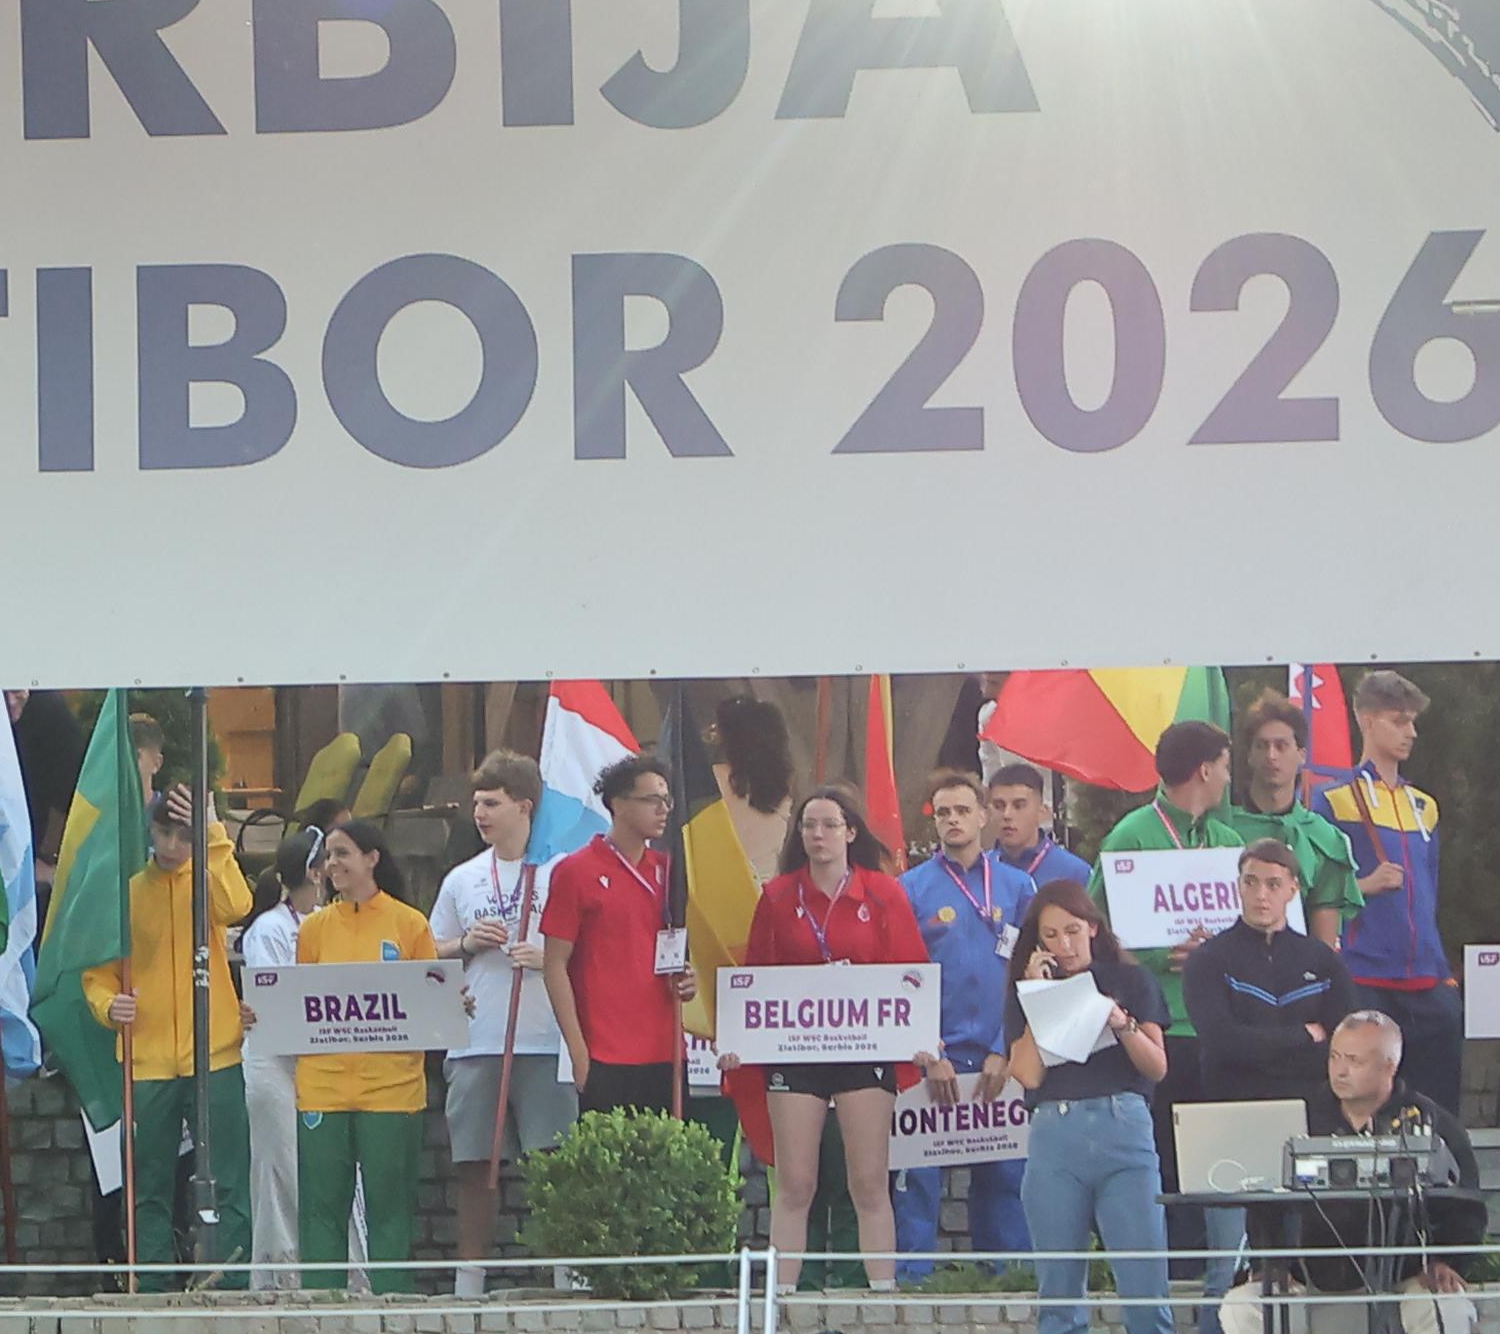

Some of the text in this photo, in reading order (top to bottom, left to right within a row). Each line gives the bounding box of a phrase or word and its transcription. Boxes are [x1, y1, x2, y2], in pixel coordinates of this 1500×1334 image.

[1154, 881, 1240, 913] ALGERI
[304, 993, 407, 1023] BRAZIL
[745, 998, 911, 1029] BELGIUM FR
[891, 1099, 1031, 1137] ONTENEG
